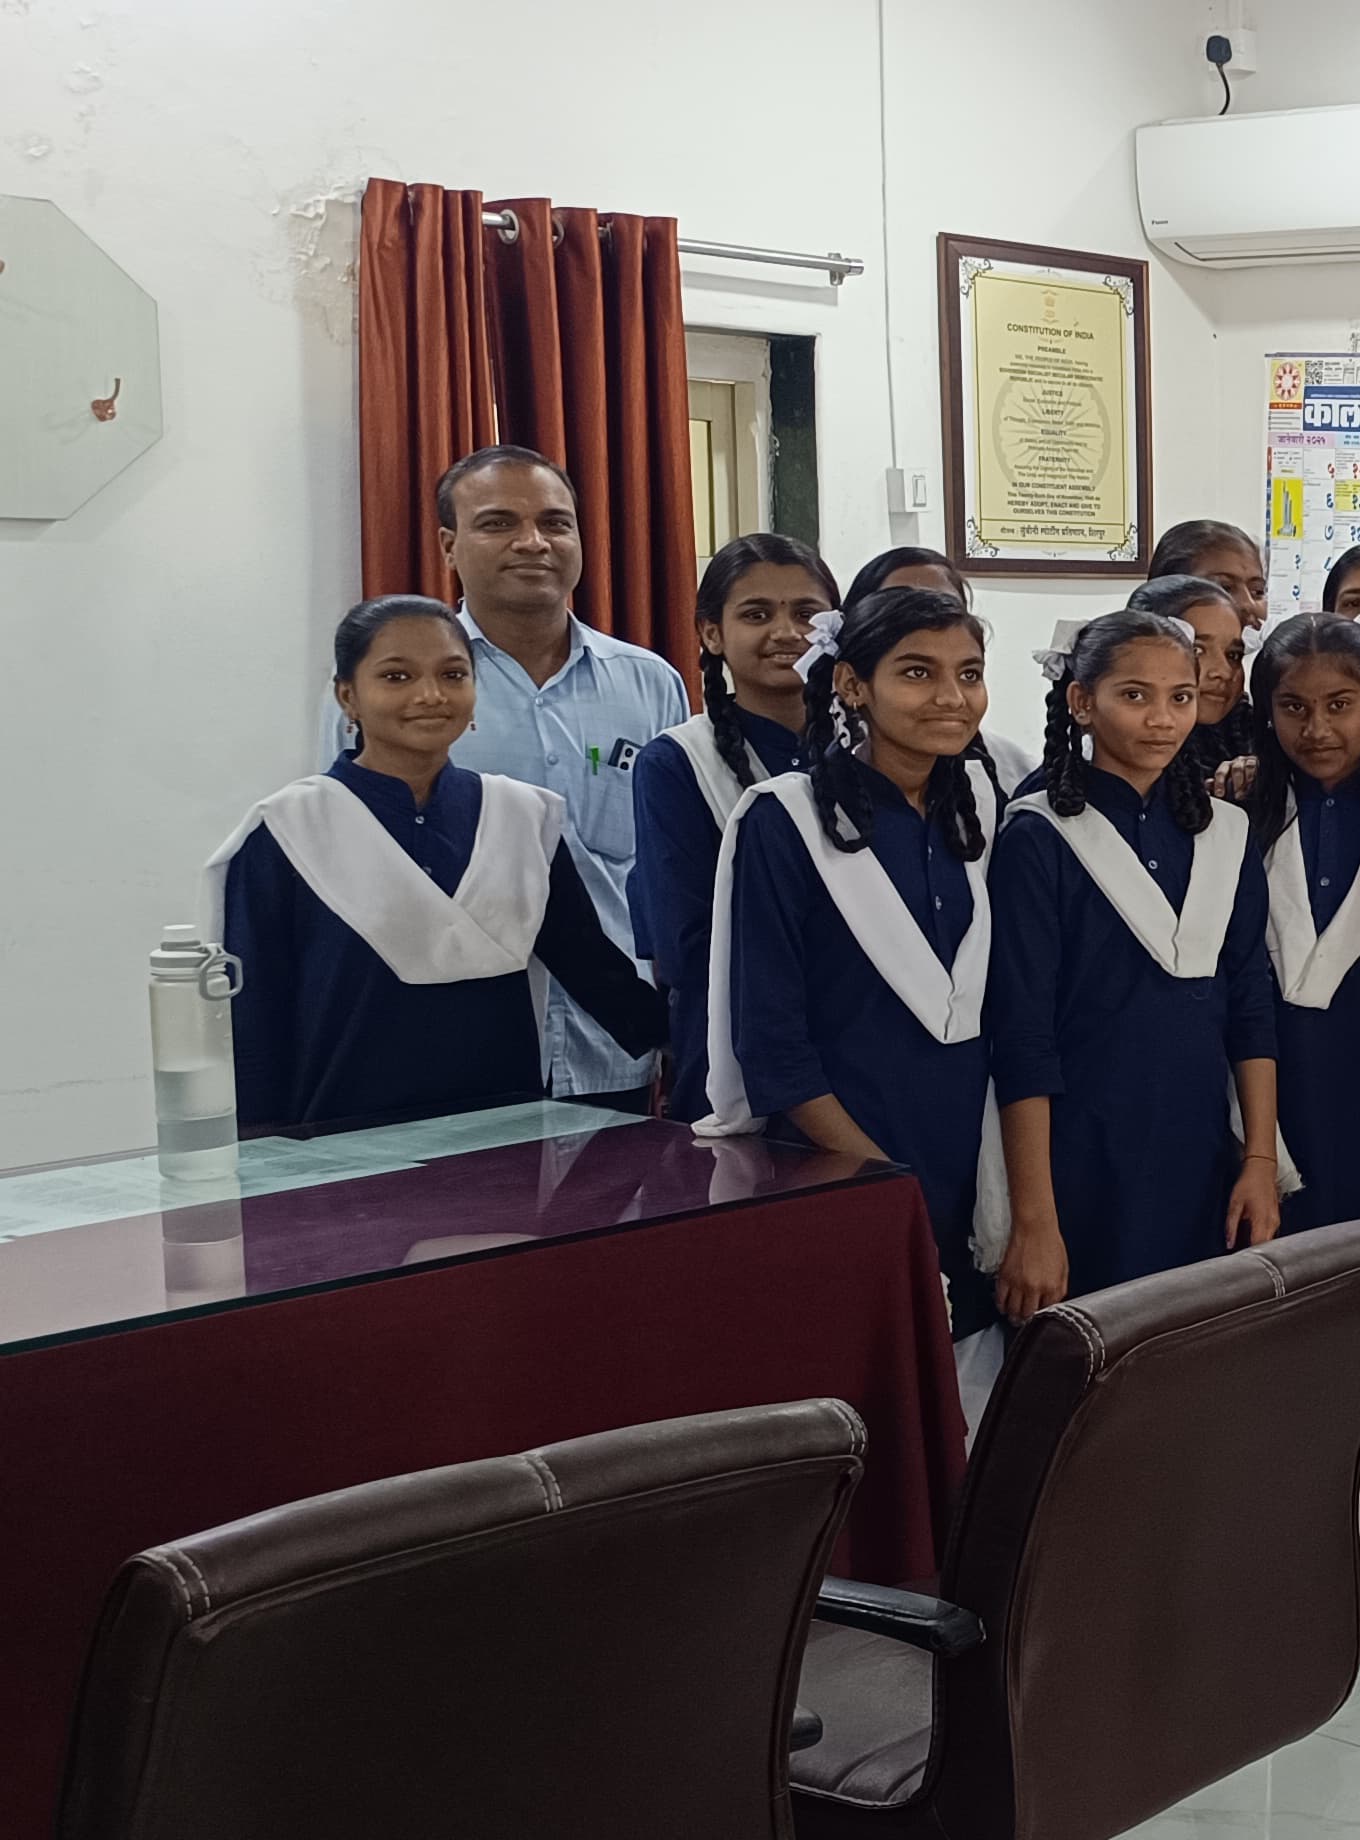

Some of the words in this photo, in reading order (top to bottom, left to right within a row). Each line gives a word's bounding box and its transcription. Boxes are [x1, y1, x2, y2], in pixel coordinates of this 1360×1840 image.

[1007, 323, 1061, 337] CONSTITUTION
[1063, 329, 1072, 338] OF
[1075, 331, 1094, 340] INDIA
